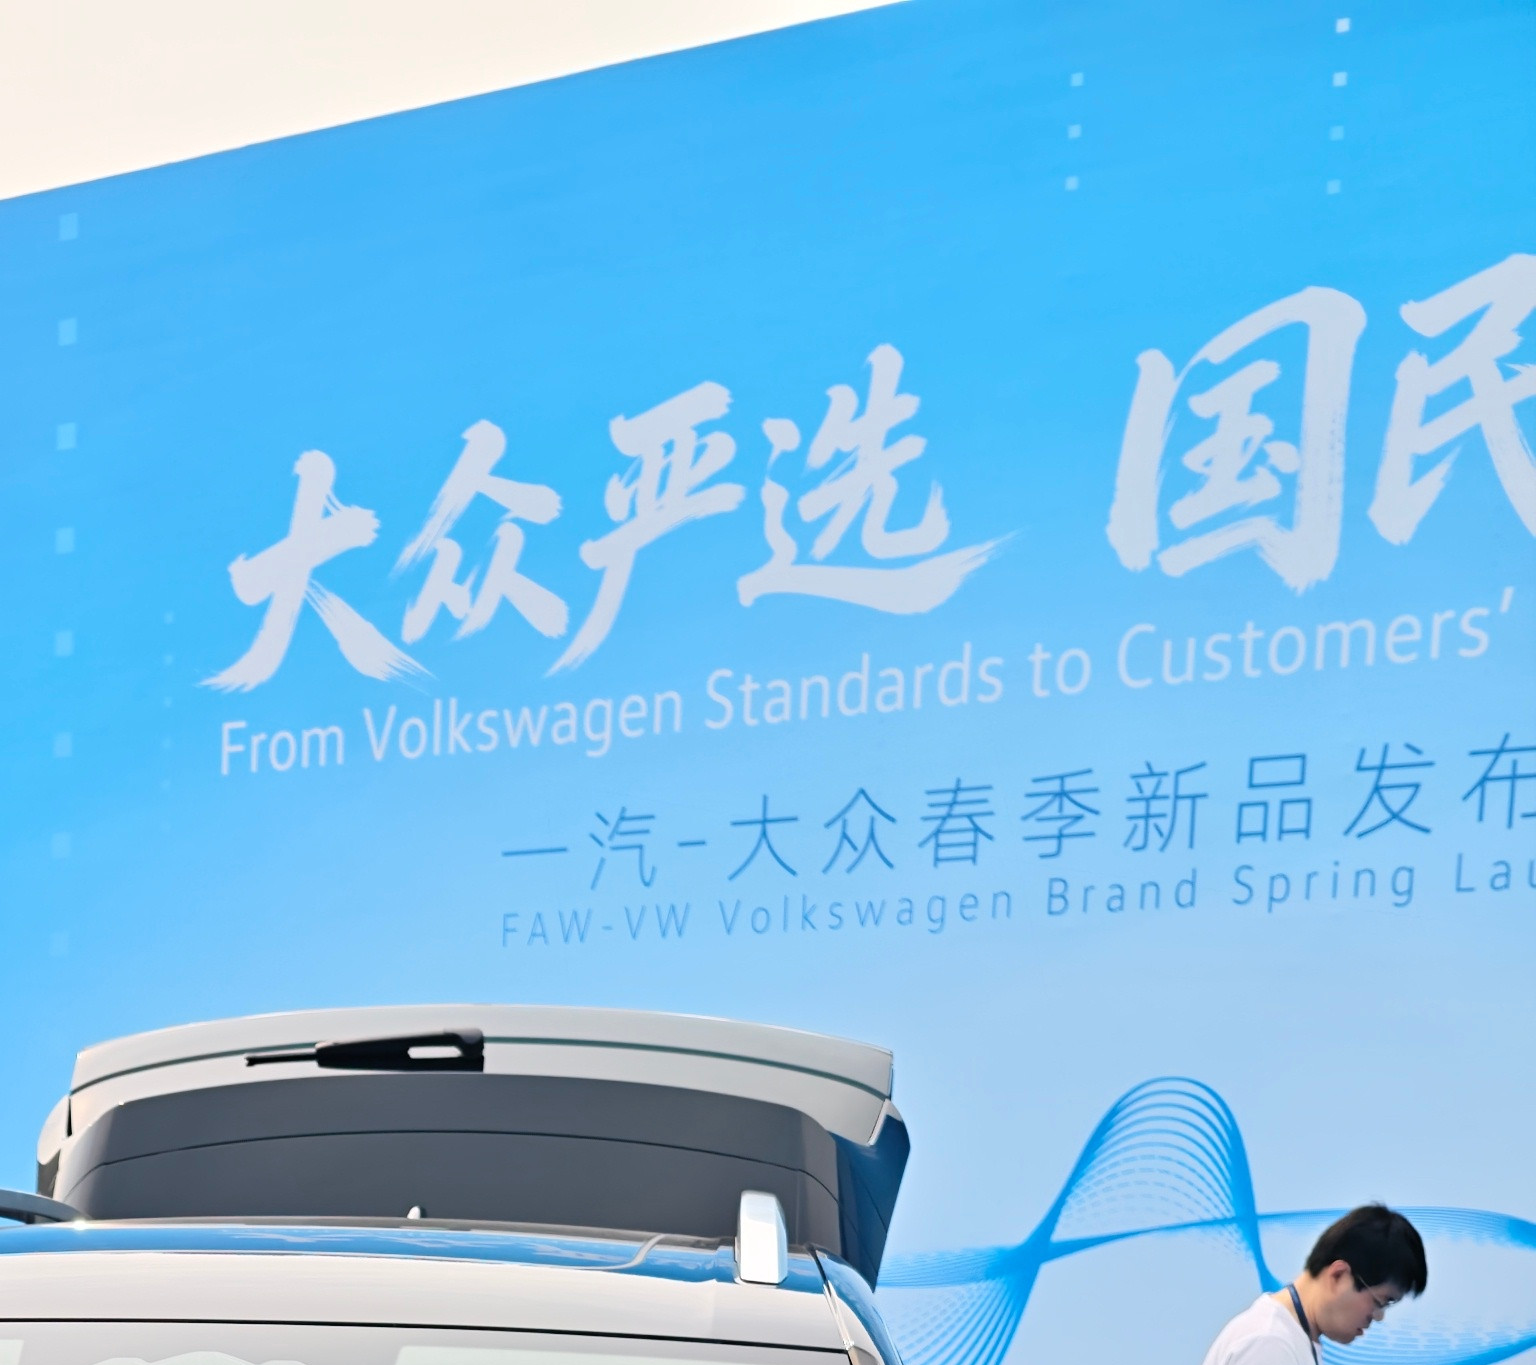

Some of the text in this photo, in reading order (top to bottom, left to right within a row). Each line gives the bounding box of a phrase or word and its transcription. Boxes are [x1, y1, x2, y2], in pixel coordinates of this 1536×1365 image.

[201, 344, 1021, 692] 大众严选
[220, 720, 345, 775] From
[363, 688, 683, 762] Volkswagen
[704, 641, 1004, 730] Standards
[1027, 641, 1092, 699] to
[501, 902, 692, 948] FAW-VW
[718, 888, 1013, 935] Volkswagen
[1047, 866, 1198, 916] Brand
[1231, 860, 1416, 913] Spring
